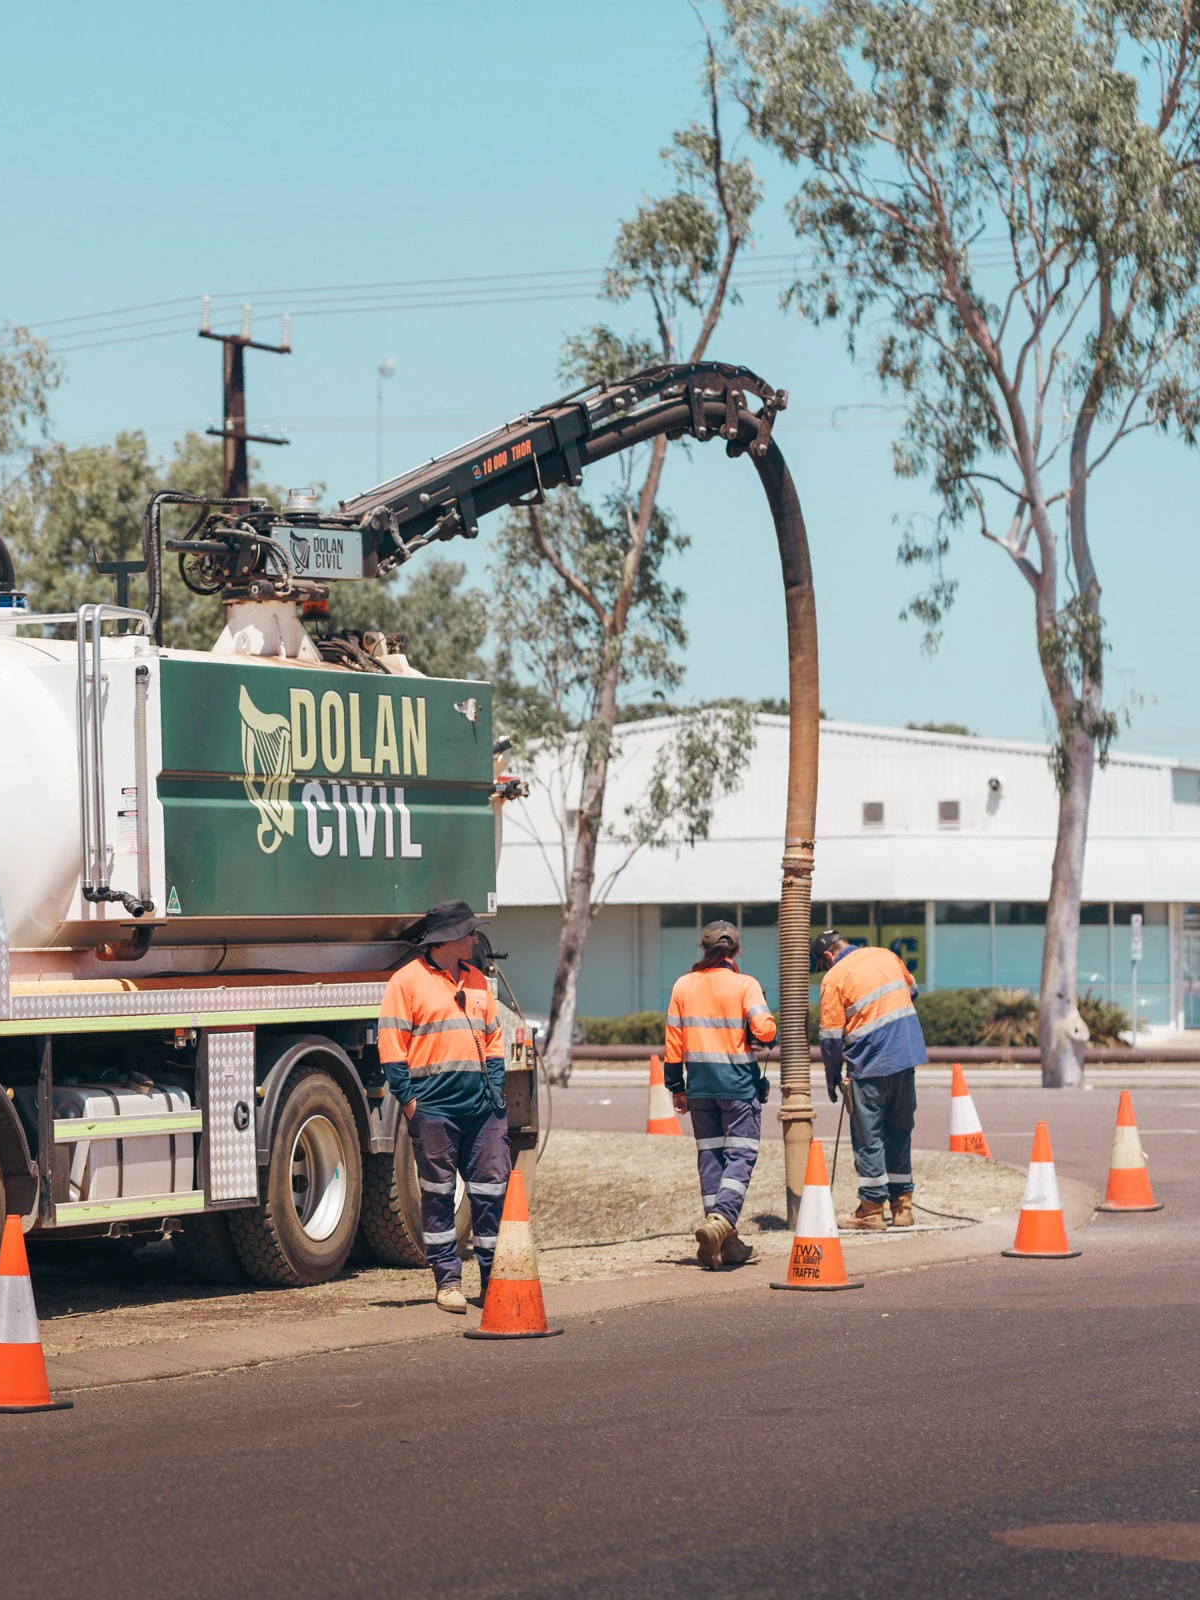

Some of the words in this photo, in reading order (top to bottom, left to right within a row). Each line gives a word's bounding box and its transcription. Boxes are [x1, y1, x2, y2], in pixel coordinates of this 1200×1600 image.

[511, 439, 532, 461] THOR
[313, 537, 344, 554] DOLAN
[315, 553, 342, 570] CIVIL
[290, 687, 428, 777] DOLAN
[301, 781, 423, 859] CIVIL
[792, 1267, 820, 1279] TRAFFIC
